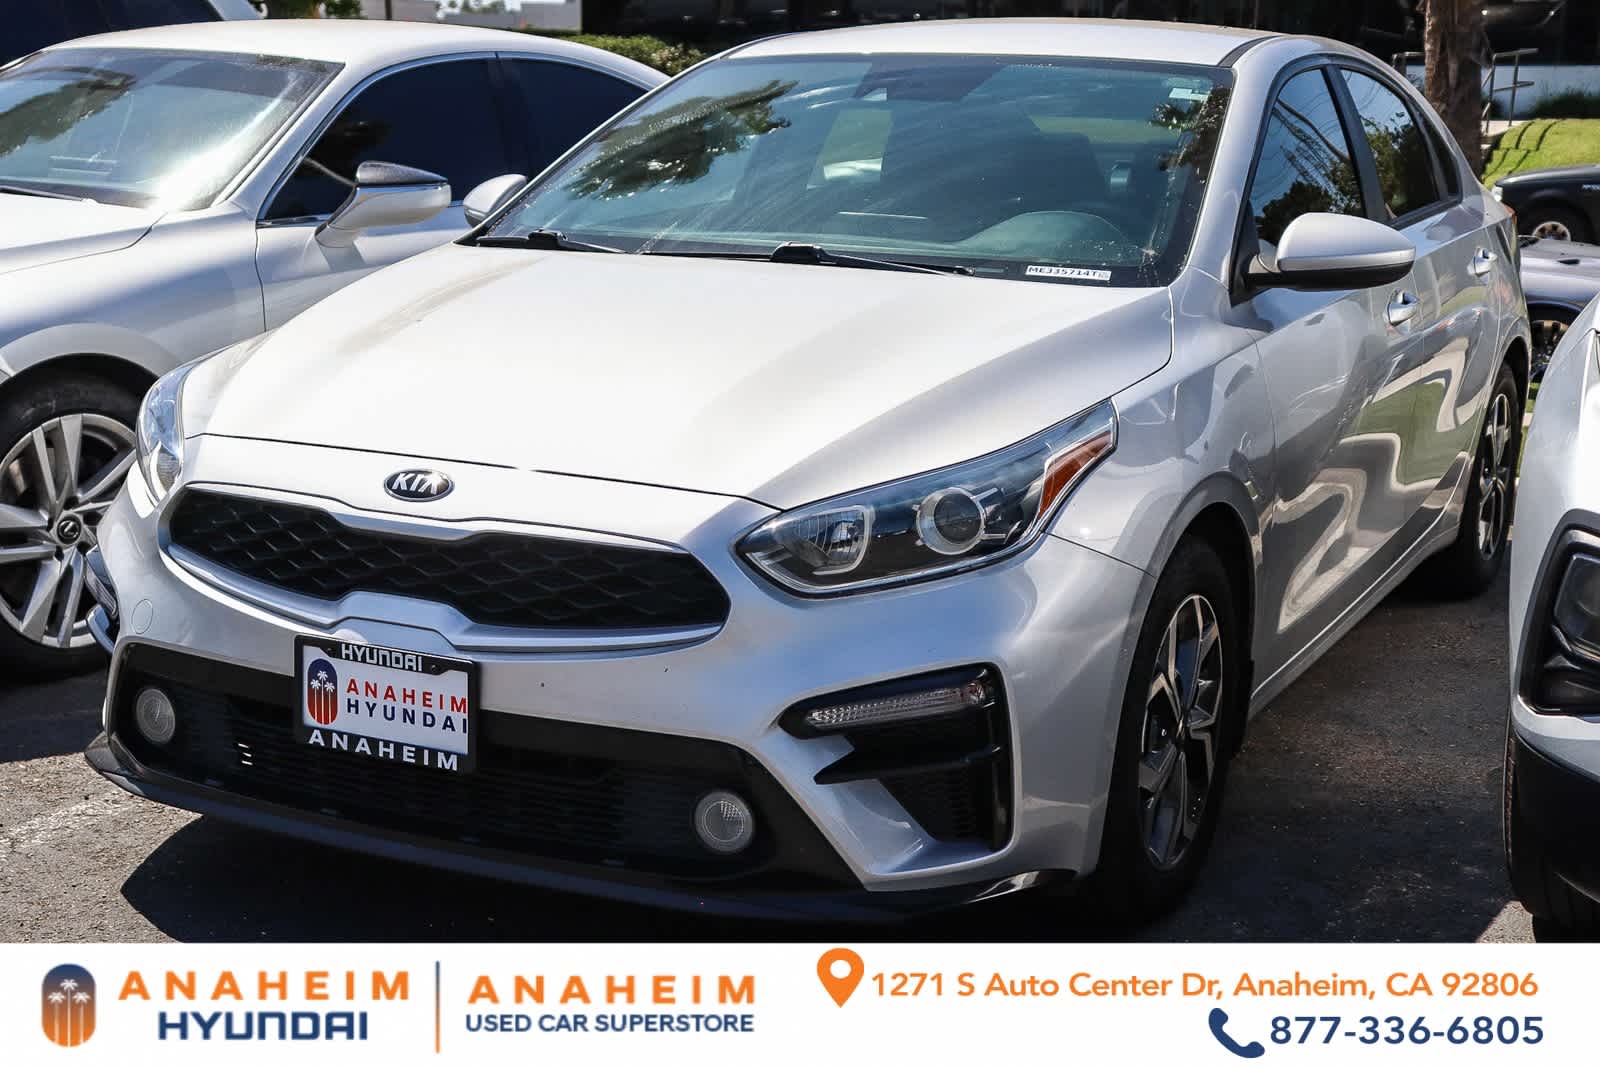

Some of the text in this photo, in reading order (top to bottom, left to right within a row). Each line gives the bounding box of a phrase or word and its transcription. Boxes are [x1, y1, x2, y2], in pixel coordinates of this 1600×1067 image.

[391, 473, 439, 495] KIA
[341, 643, 422, 672] HYUNDAI
[347, 678, 467, 714] ANAHEIM
[347, 698, 467, 734] HYUNDAI
[308, 729, 458, 771] ANAHEIM
